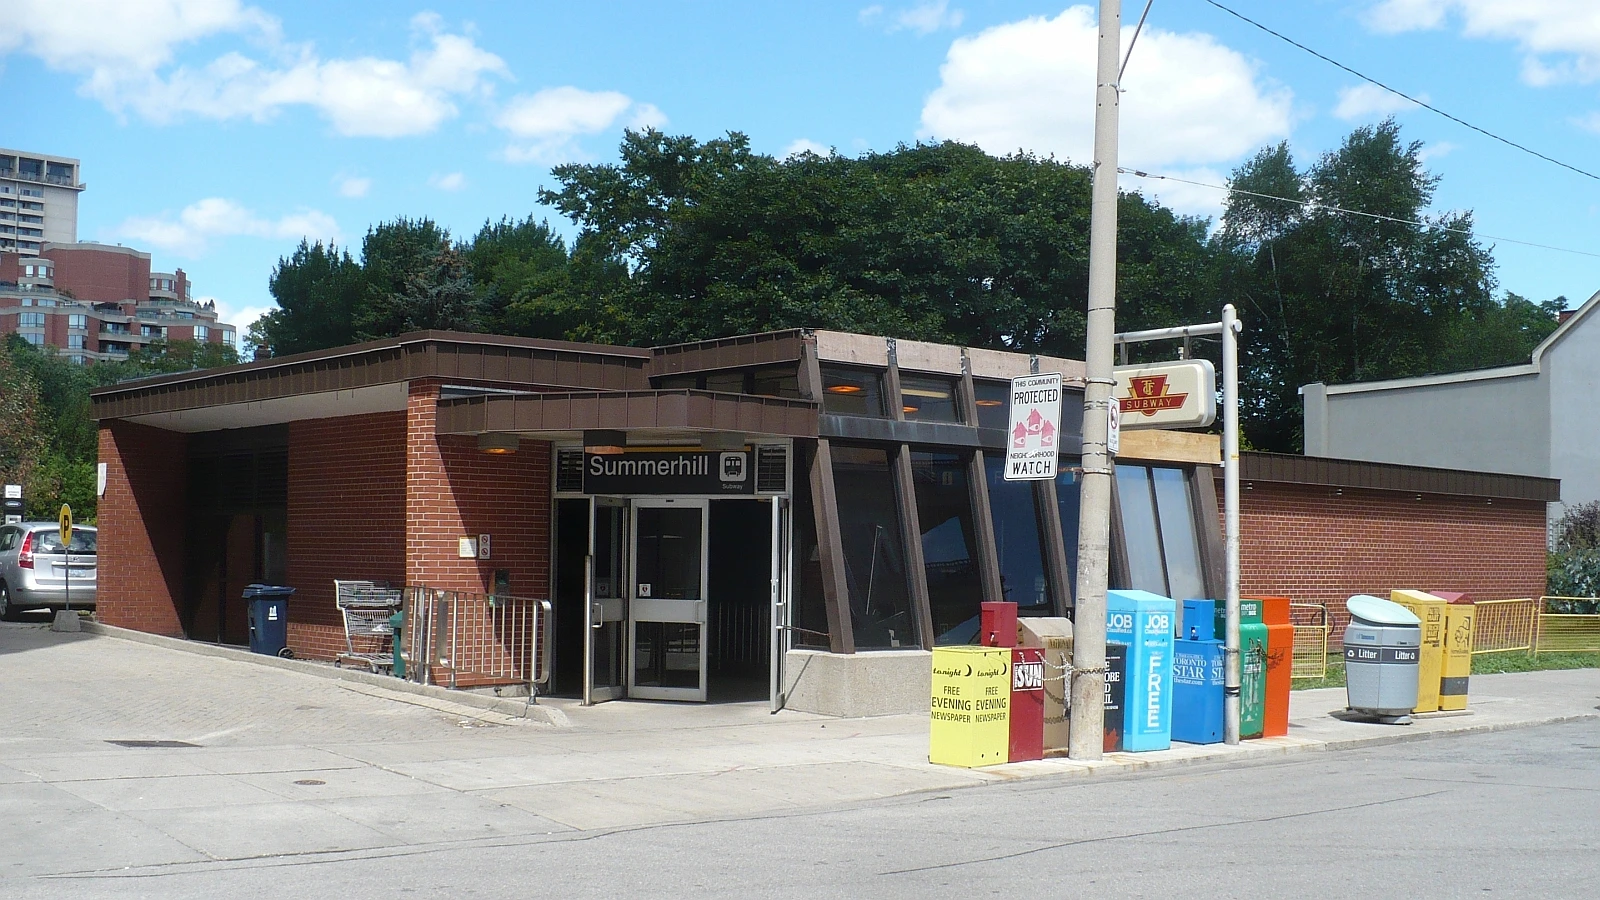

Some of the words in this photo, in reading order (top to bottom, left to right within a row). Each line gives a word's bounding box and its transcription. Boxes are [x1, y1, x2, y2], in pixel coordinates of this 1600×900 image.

[1028, 378, 1059, 386] COMMUNITY
[1014, 389, 1058, 405] PROTECTED
[1127, 398, 1172, 409] SUBWAY
[590, 455, 709, 476] Summerhill
[1013, 460, 1051, 475] WATCH
[63, 515, 69, 538] P
[1107, 614, 1132, 628] JOB
[1145, 615, 1169, 628] JOB
[1358, 649, 1377, 659] Litter
[1395, 651, 1410, 659] Litter
[1173, 657, 1207, 668] TORONTO
[933, 668, 962, 678] tonight
[977, 669, 999, 678] tonight
[1017, 664, 1042, 687] SUN
[1173, 665, 1205, 678] STAR
[943, 686, 960, 695] FREE
[985, 687, 998, 695] FREE
[1147, 656, 1161, 727] FREE
[932, 697, 971, 711] EVENING
[976, 698, 1006, 710] EVENING
[931, 711, 971, 723] NEWSPAPER
[976, 712, 1006, 722] NEWSPAPER
